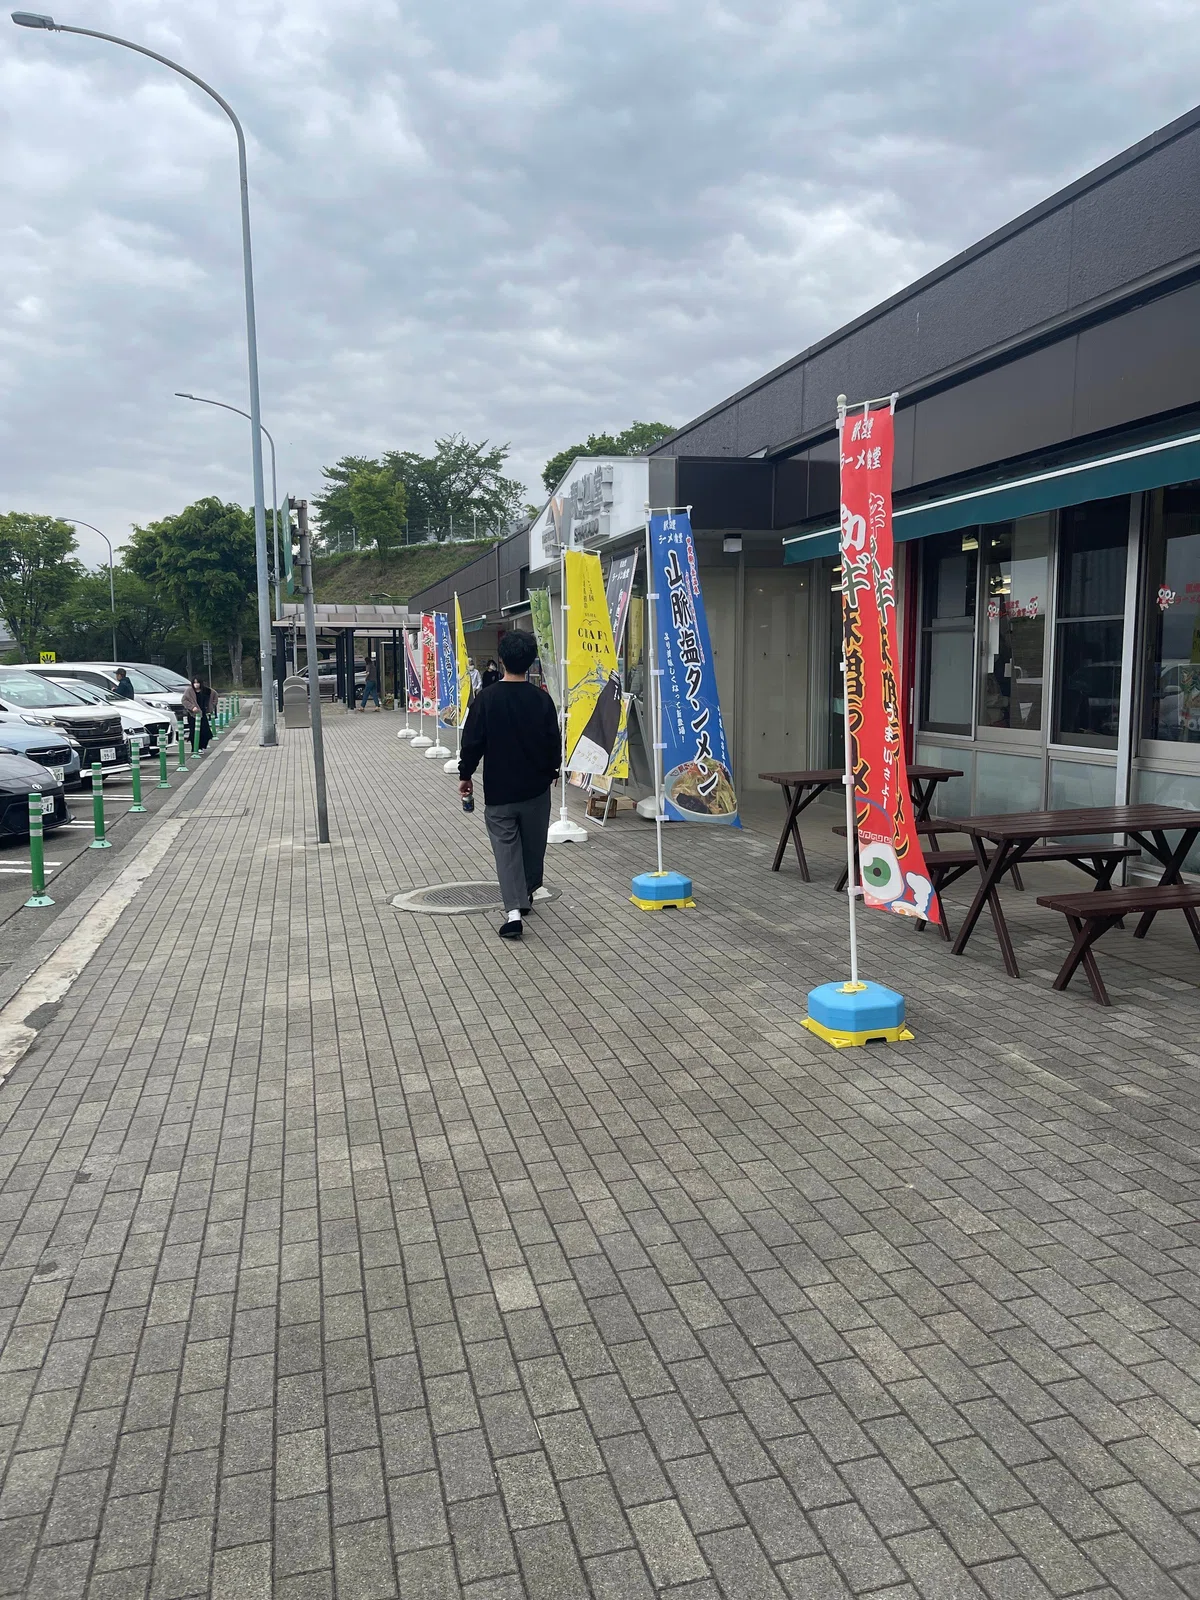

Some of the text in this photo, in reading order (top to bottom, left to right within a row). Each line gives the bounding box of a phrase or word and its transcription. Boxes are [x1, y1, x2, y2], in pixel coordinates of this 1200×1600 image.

[582, 641, 610, 655] COLA
[664, 549, 719, 797] 山脈塩タンメン
